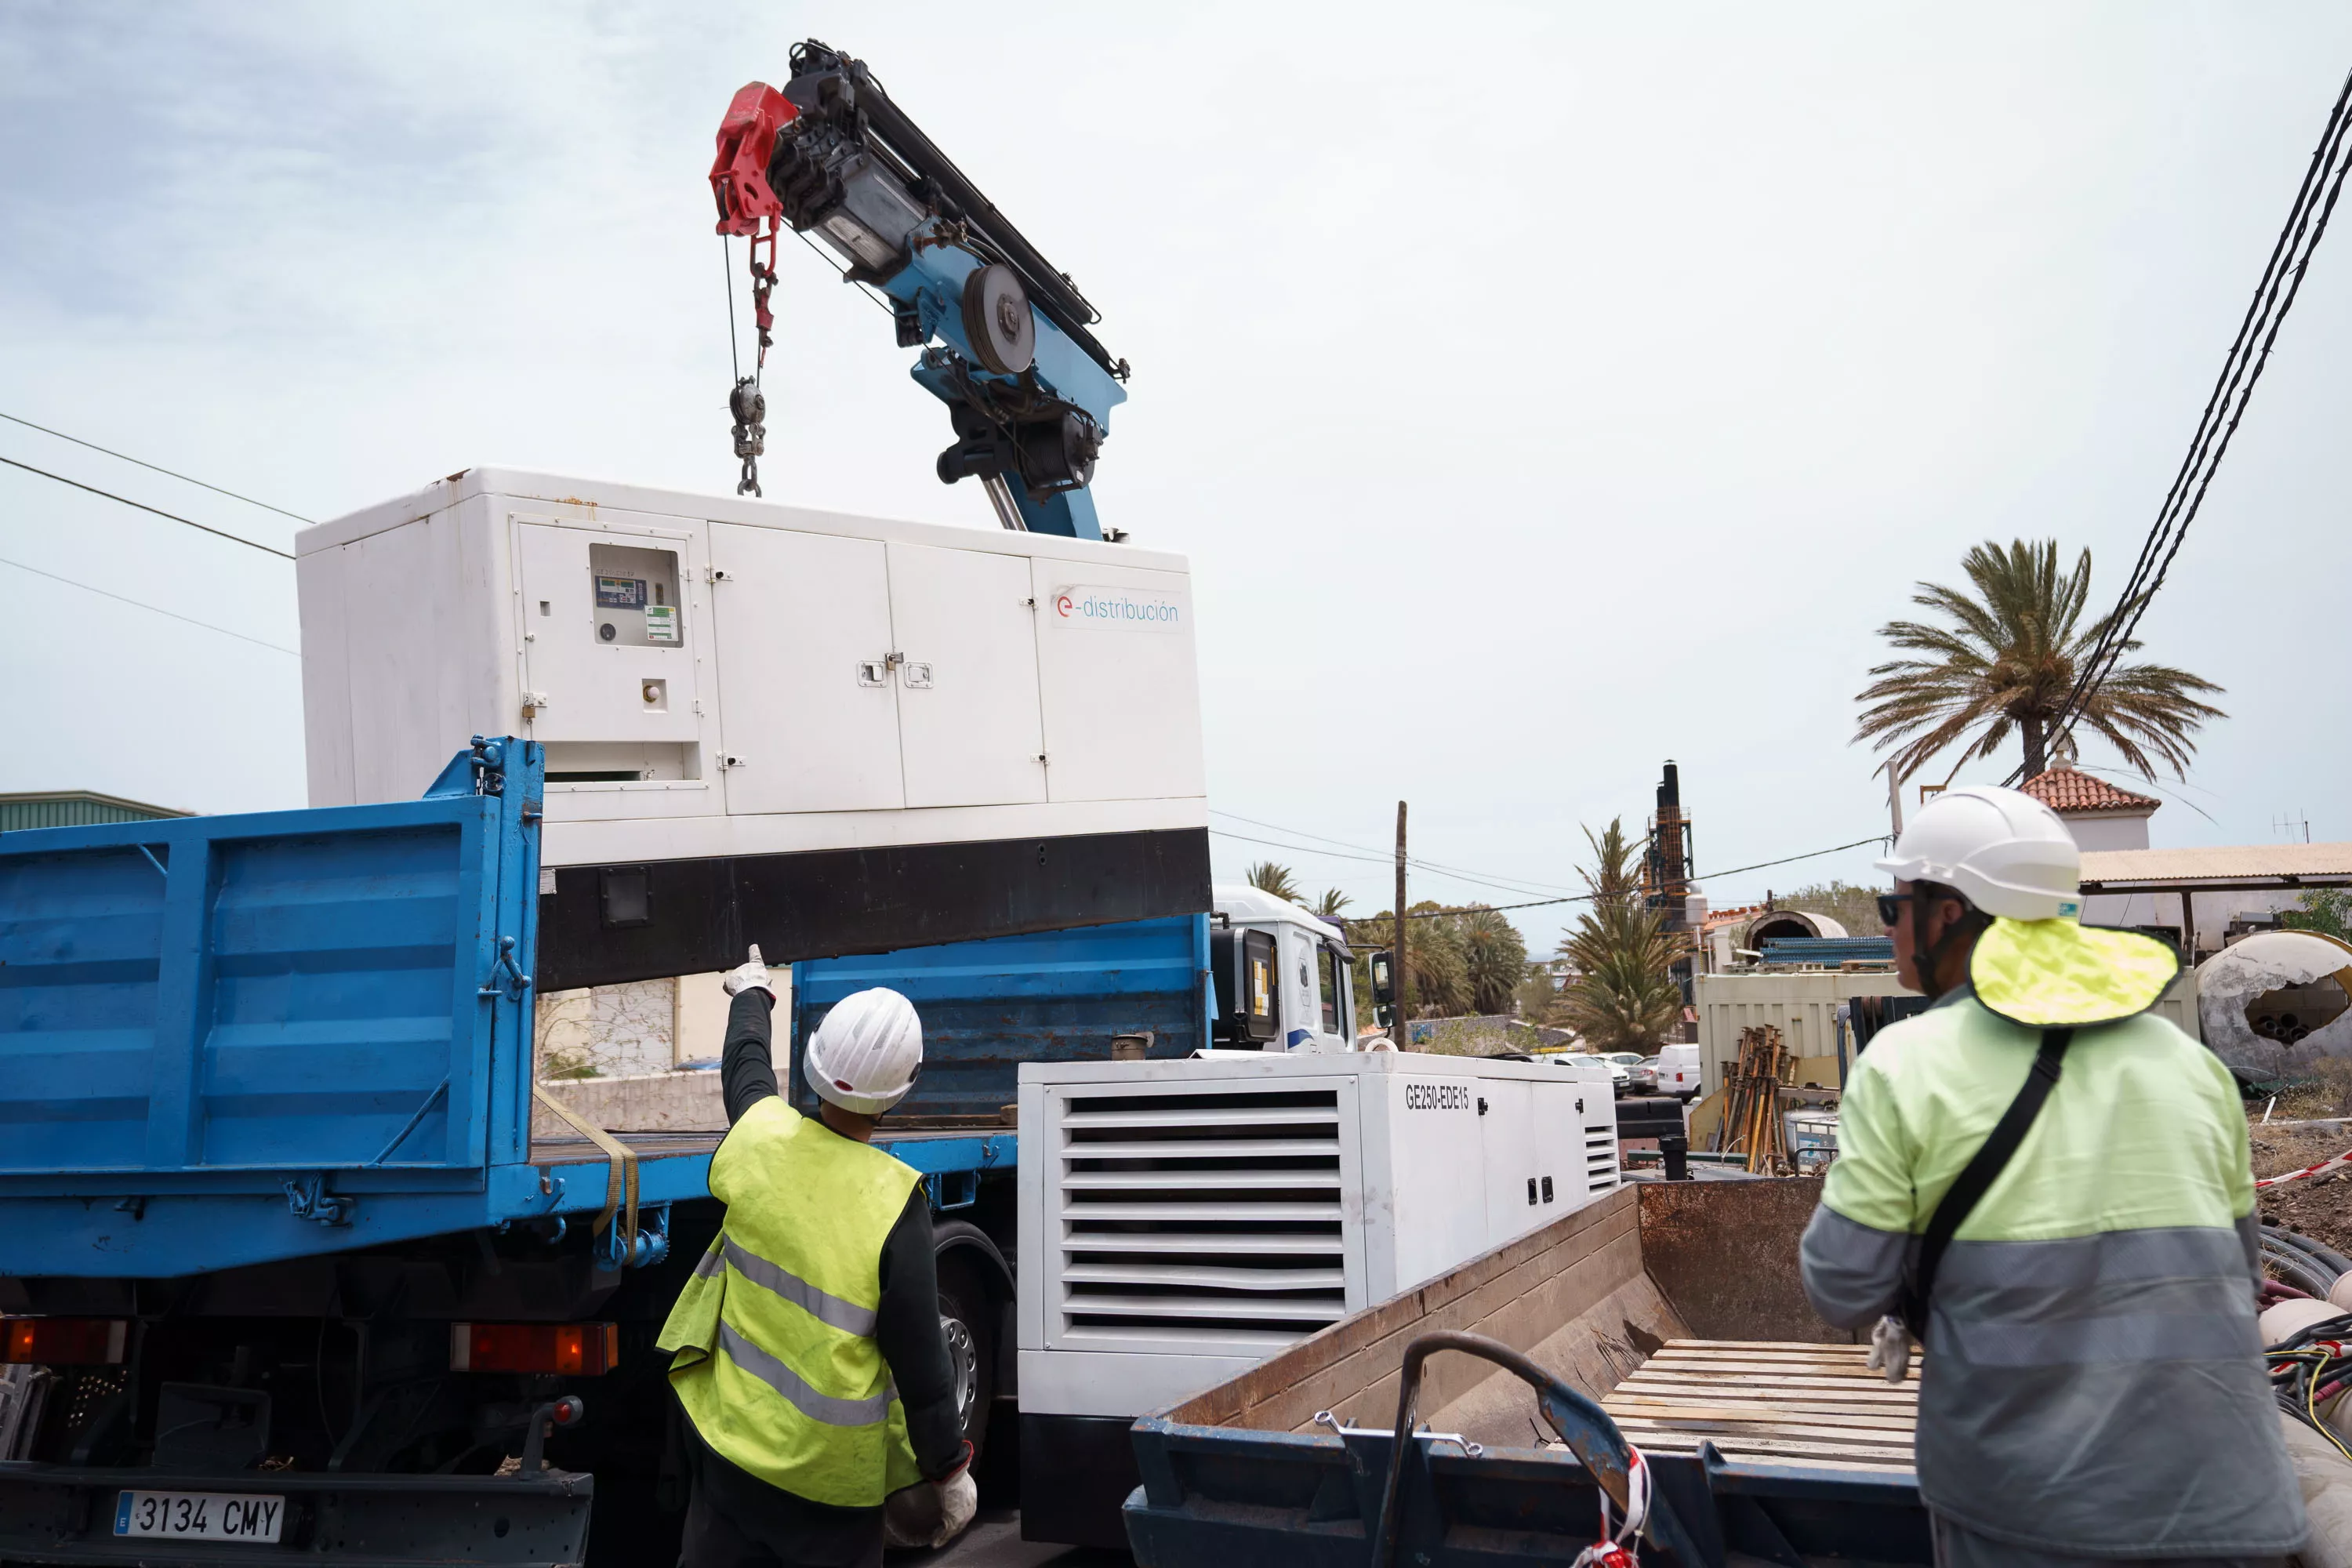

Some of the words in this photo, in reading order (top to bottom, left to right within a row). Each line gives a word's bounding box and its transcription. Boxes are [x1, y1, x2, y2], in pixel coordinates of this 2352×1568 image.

[1057, 595, 1178, 622] e-distribución
[1406, 1083, 1468, 1110] GE250-EDE15
[119, 1517, 127, 1527] E
[140, 1497, 207, 1533] 3134
[223, 1500, 279, 1536] CMY
